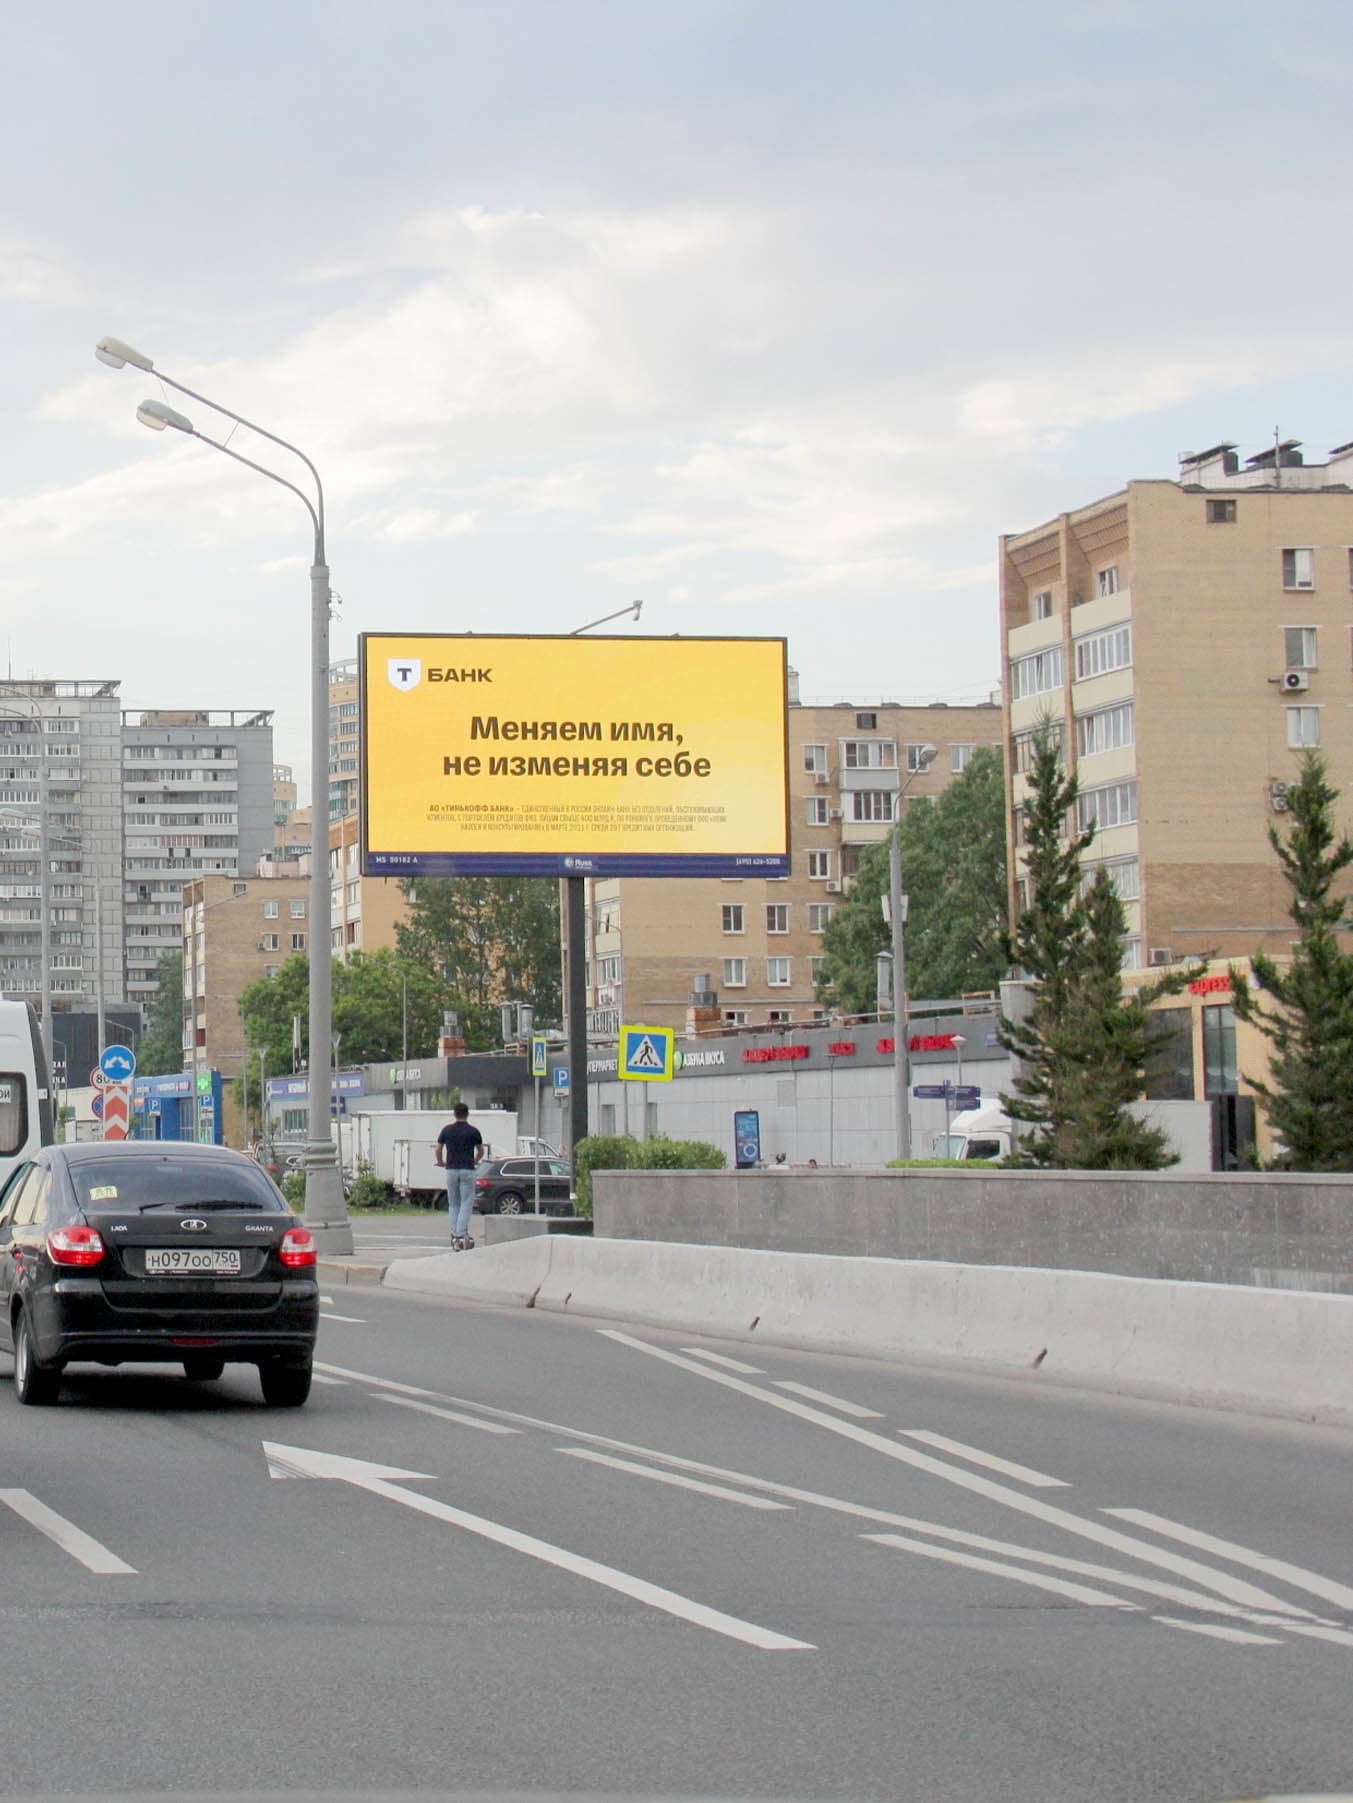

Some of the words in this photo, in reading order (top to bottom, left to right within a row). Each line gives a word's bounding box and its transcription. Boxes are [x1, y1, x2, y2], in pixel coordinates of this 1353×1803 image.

[427, 668, 493, 682] БАНК
[470, 716, 602, 741] Меняем
[610, 721, 684, 746] имя,
[443, 755, 481, 776] не
[489, 756, 628, 777] изменяя
[635, 751, 712, 778] себе
[558, 1070, 568, 1085] P
[151, 1252, 212, 1268] Н097ОО
[214, 1251, 236, 1264] 750
